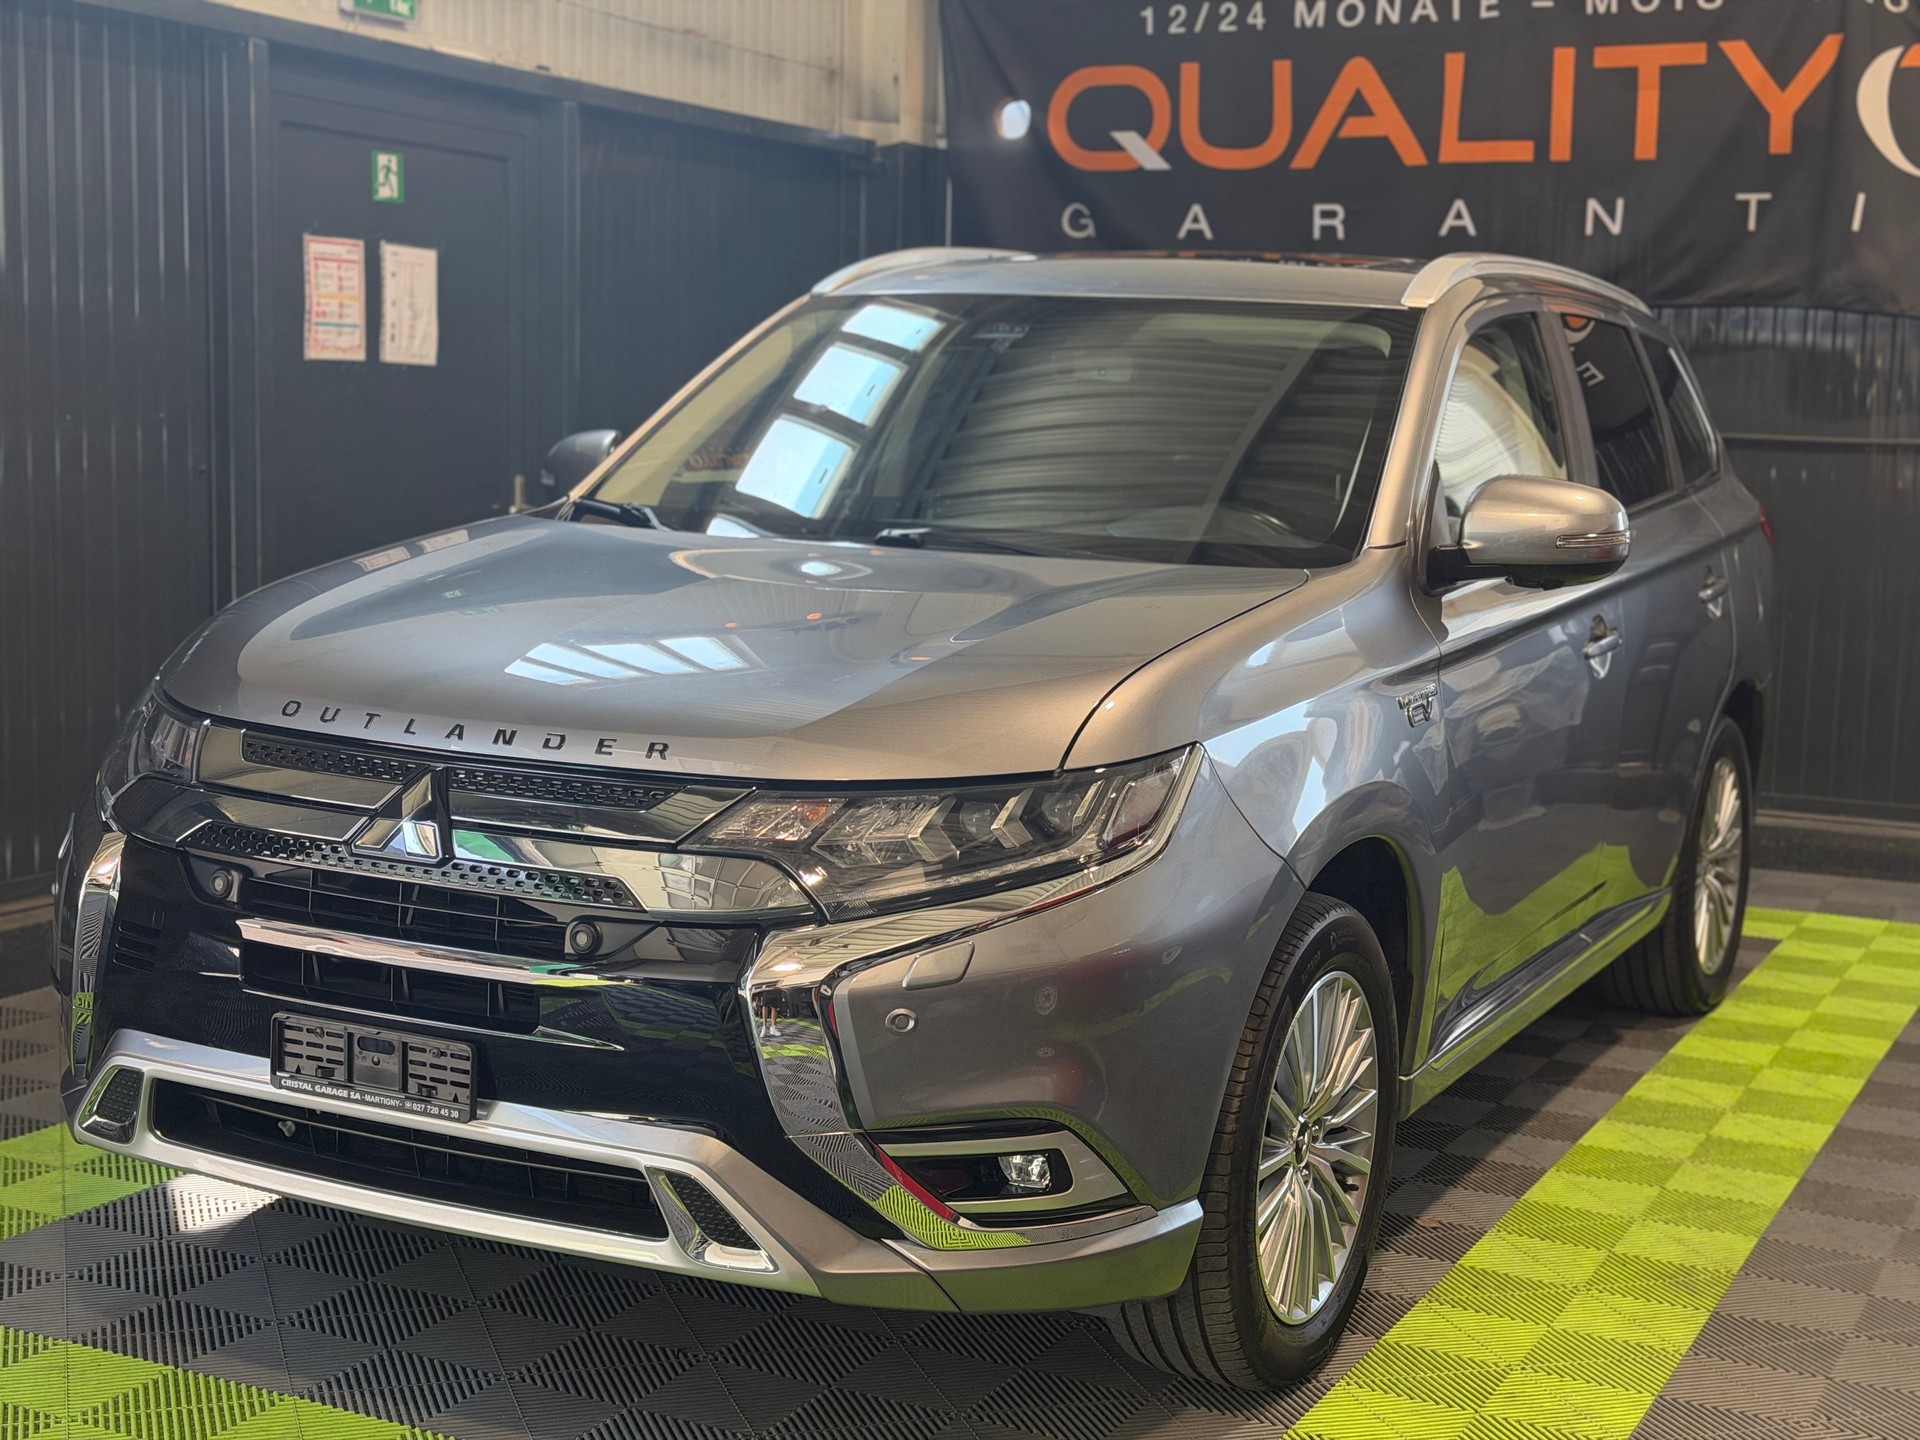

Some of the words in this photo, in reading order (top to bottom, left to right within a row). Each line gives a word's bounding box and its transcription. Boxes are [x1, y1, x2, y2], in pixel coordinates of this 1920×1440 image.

[1138, 1, 1267, 36] 12/24
[1047, 32, 1844, 172] QUALITY
[1060, 192, 1867, 241] GARANTI
[281, 700, 670, 761] OUTLANDER
[280, 1078, 313, 1091] CRISTAL
[314, 1084, 349, 1098] GARAGE
[349, 1091, 361, 1100] SA
[412, 1103, 426, 1112] 027
[426, 1105, 439, 1115] 720
[439, 1108, 449, 1117] 45
[450, 1110, 459, 1119] 30
